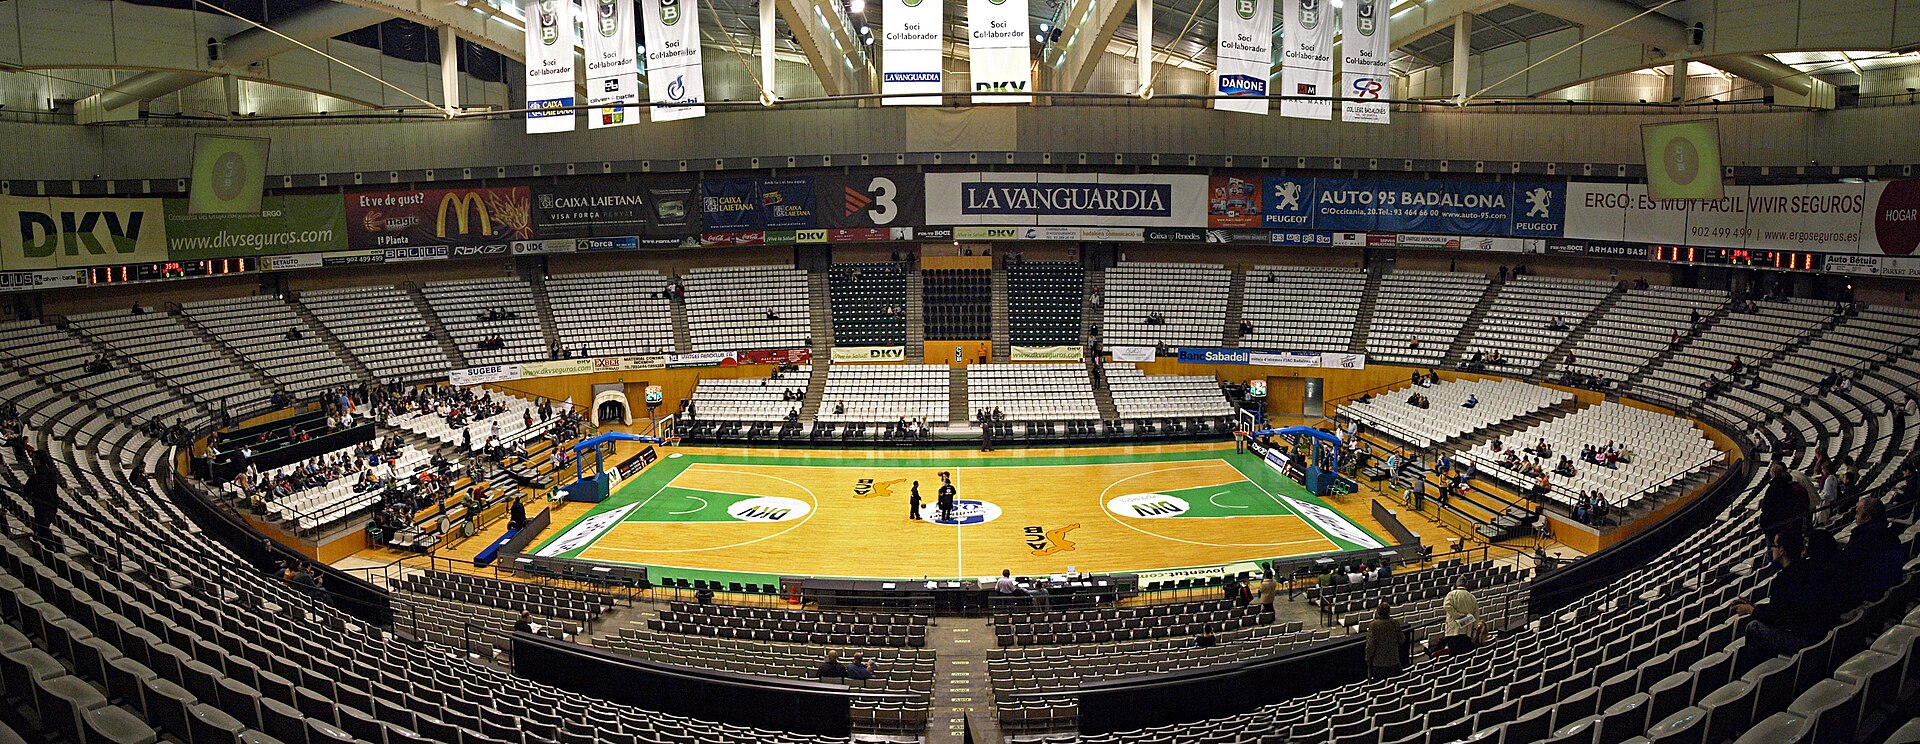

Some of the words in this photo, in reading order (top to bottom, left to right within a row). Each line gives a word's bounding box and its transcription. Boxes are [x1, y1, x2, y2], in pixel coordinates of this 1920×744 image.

[904, 22, 920, 31] Soci
[990, 20, 1007, 28] Soci
[1238, 33, 1252, 42] Soci
[664, 40, 680, 48] Soci
[1300, 43, 1314, 52] Soci
[603, 51, 617, 59] Soci
[1360, 50, 1372, 58] Soci
[543, 59, 557, 67] Soci
[885, 73, 894, 82] LA
[976, 80, 1026, 92] DKV
[1222, 77, 1264, 92] DANONE
[542, 100, 563, 109] CAIXA
[360, 195, 371, 208] Et
[372, 196, 383, 206] ve
[384, 194, 396, 206] de
[398, 192, 426, 208] gust?
[554, 196, 586, 208] CAIXA
[591, 195, 643, 207] LAIETANA
[719, 196, 742, 204] CAIXA
[867, 176, 898, 225] 3
[968, 188, 999, 210] LA
[1000, 186, 1166, 212] VANGUARDIA
[1320, 190, 1373, 205] AUTO
[1378, 191, 1396, 205] 95
[1402, 192, 1506, 208] BADALONA
[1585, 192, 1634, 209] ERGO:
[1638, 195, 1657, 210] ES
[1661, 198, 1698, 211] MUY
[1749, 196, 1788, 213] VIVIR
[1790, 194, 1863, 214] SEGUROS
[720, 204, 754, 212] LAIETANA
[262, 210, 282, 218] ERGO
[1266, 214, 1308, 224] PEUGEOT
[1442, 212, 1506, 220] www.auto-95.com
[1885, 208, 1918, 222] HOGAR
[386, 216, 420, 230] magic
[1516, 222, 1558, 231] PEUGEOT
[18, 210, 144, 258] DKV
[987, 229, 1016, 237] DKV
[1150, 232, 1168, 240] Caixa
[1692, 226, 1710, 238] 902
[1712, 226, 1732, 238] 499
[1732, 227, 1752, 238] 499
[1764, 229, 1858, 244] www.ergoseguros.es
[170, 228, 332, 250] www.dkvseguros.com
[386, 235, 409, 246] Planta
[590, 240, 613, 248] Torca
[385, 246, 448, 258] BALIUS
[526, 242, 543, 252] UDE
[1588, 246, 1624, 254] ARMAND
[870, 349, 902, 358] DKV
[594, 358, 620, 367] EXBER
[468, 366, 502, 376] SUGEBE
[522, 364, 592, 376] www.dkvseguros.com
[736, 506, 792, 520] DKV
[1132, 500, 1184, 516] DKV
[1023, 526, 1048, 550] ACB
